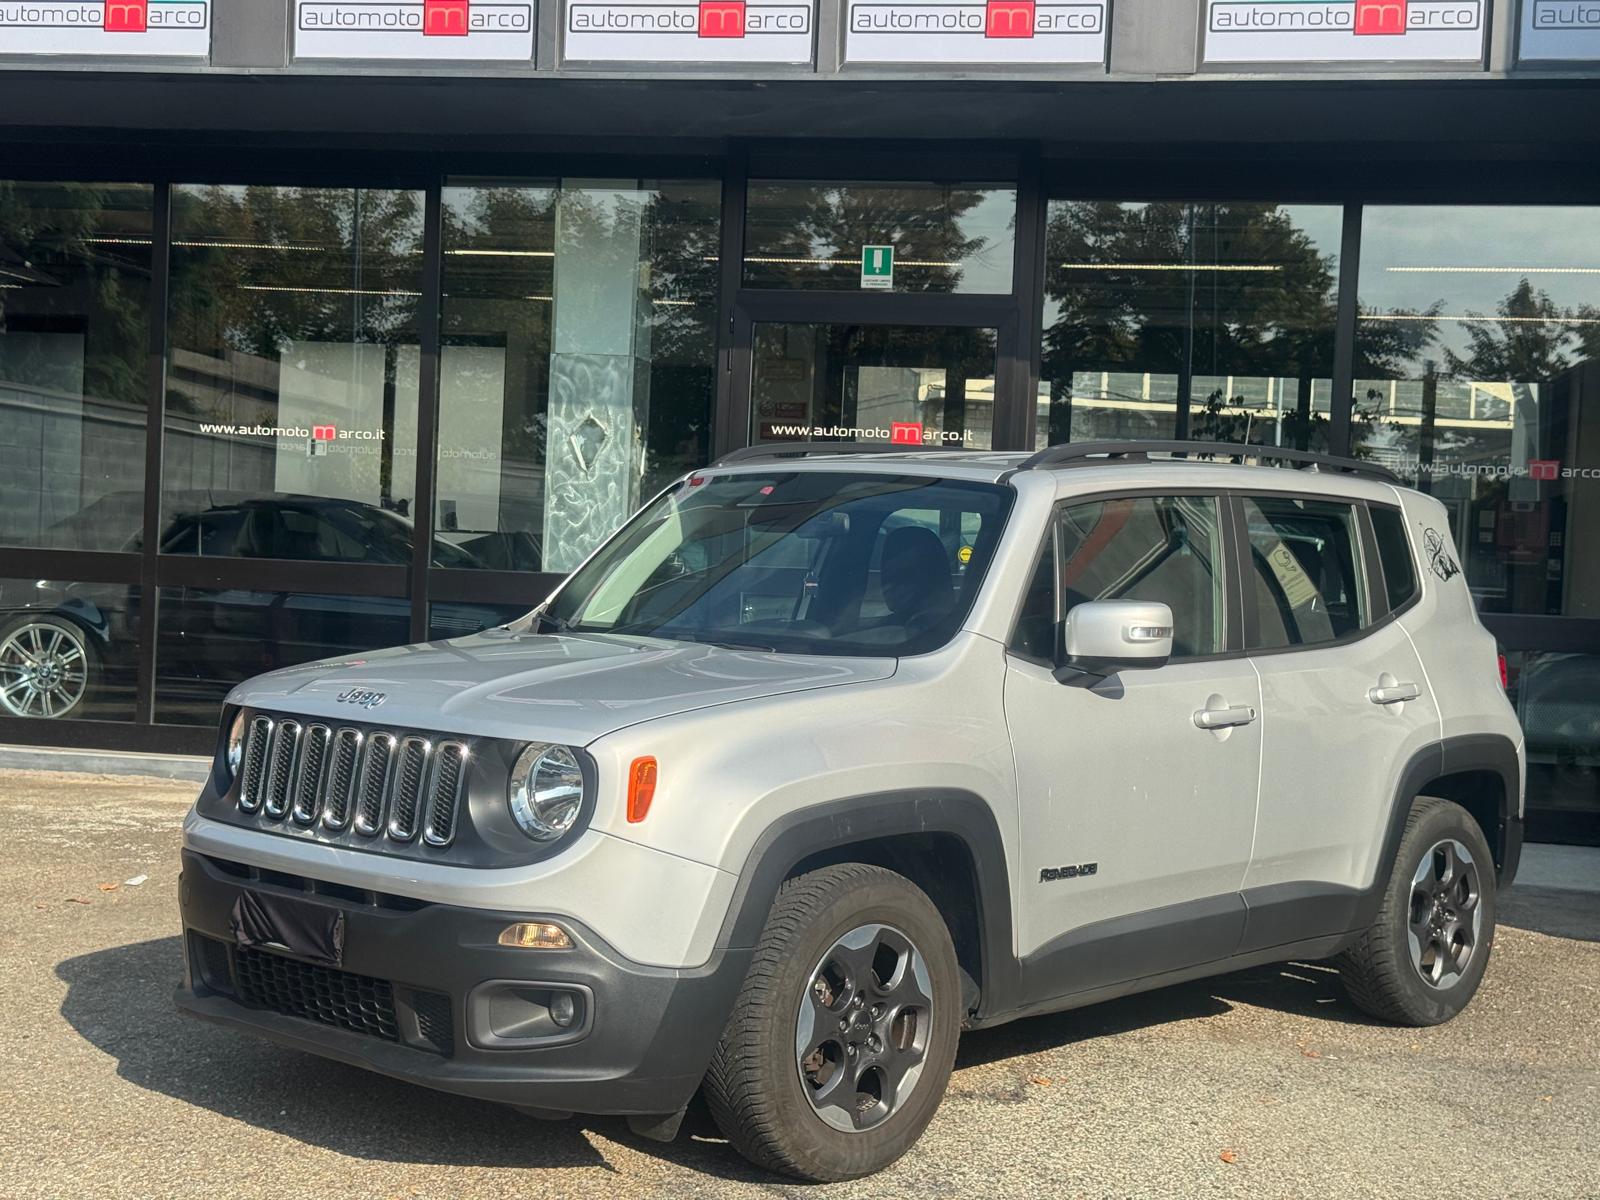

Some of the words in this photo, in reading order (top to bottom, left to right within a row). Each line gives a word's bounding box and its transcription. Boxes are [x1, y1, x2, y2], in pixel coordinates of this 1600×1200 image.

[0, 5, 101, 22] utomoto
[304, 8, 421, 27] automoto
[575, 10, 696, 29] automoto
[856, 10, 982, 29] automoto
[1216, 8, 1350, 27] automoto
[336, 688, 385, 710] Jeep
